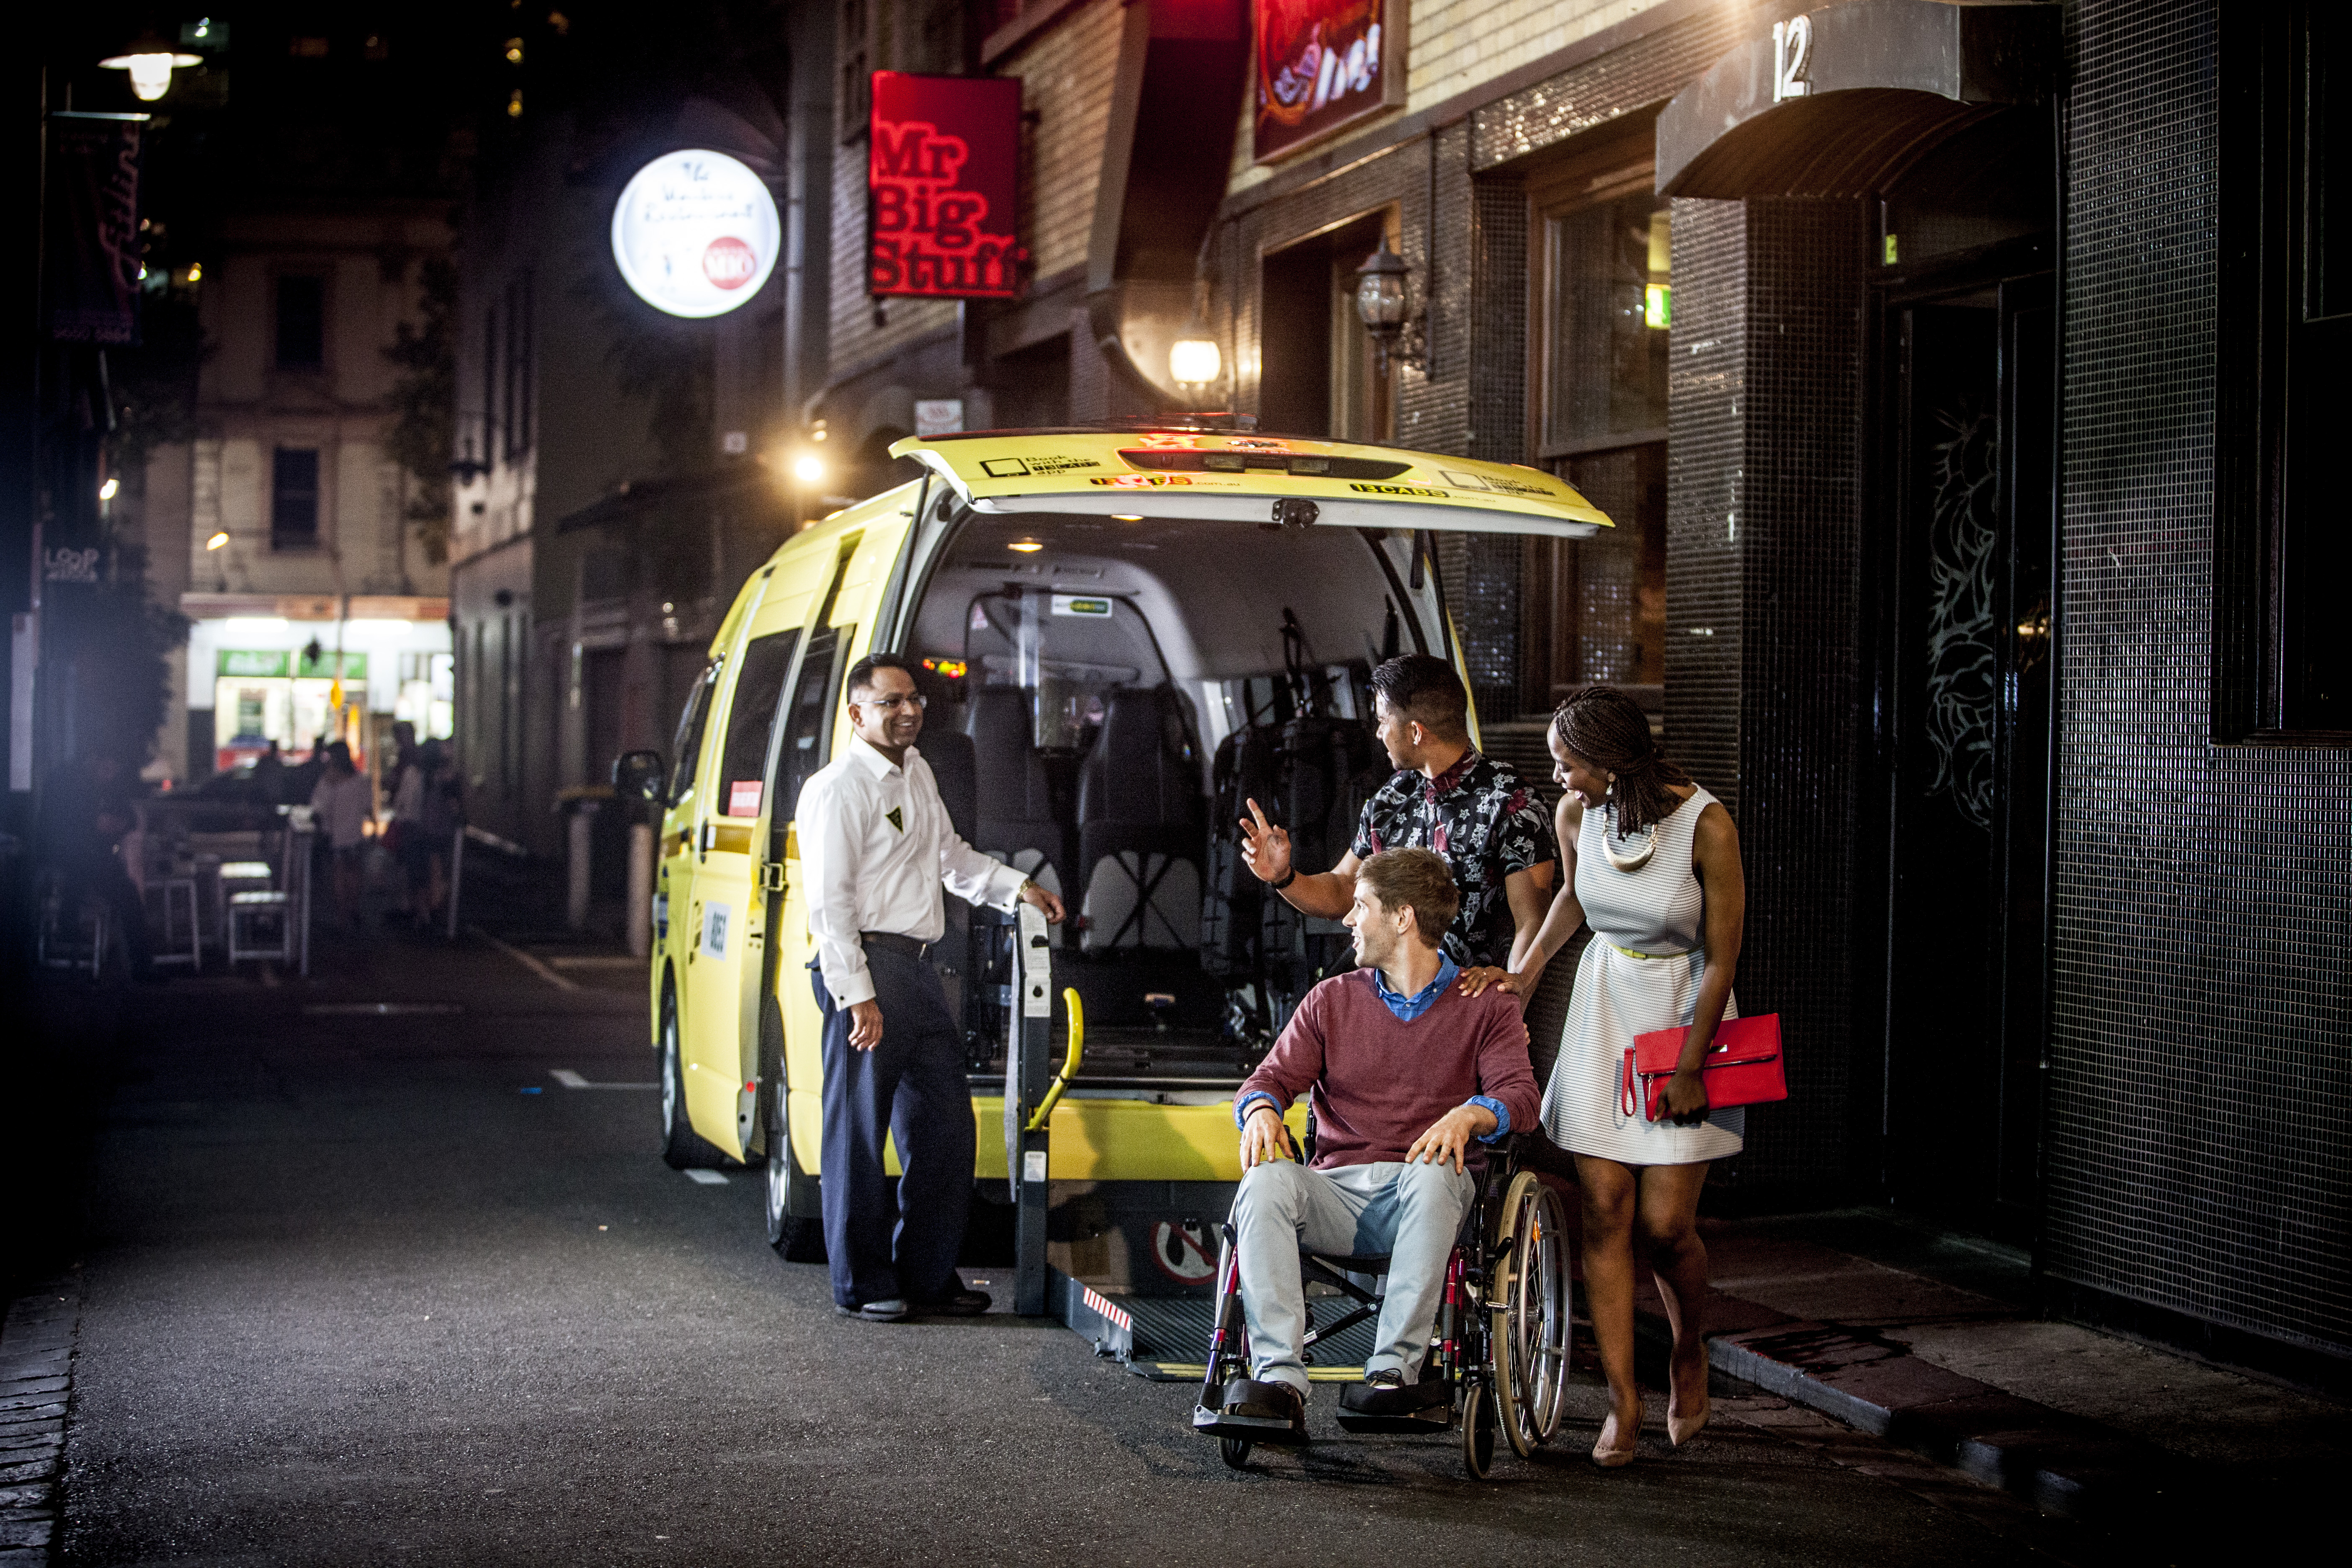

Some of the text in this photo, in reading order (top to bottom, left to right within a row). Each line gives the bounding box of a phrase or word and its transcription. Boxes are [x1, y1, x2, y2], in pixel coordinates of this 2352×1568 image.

[1772, 15, 1808, 103] 12
[875, 126, 963, 181] Mr
[874, 184, 982, 250] Big
[872, 238, 1018, 291] Stuff
[1032, 462, 1101, 471] 13CABS
[44, 546, 99, 570] LOOP
